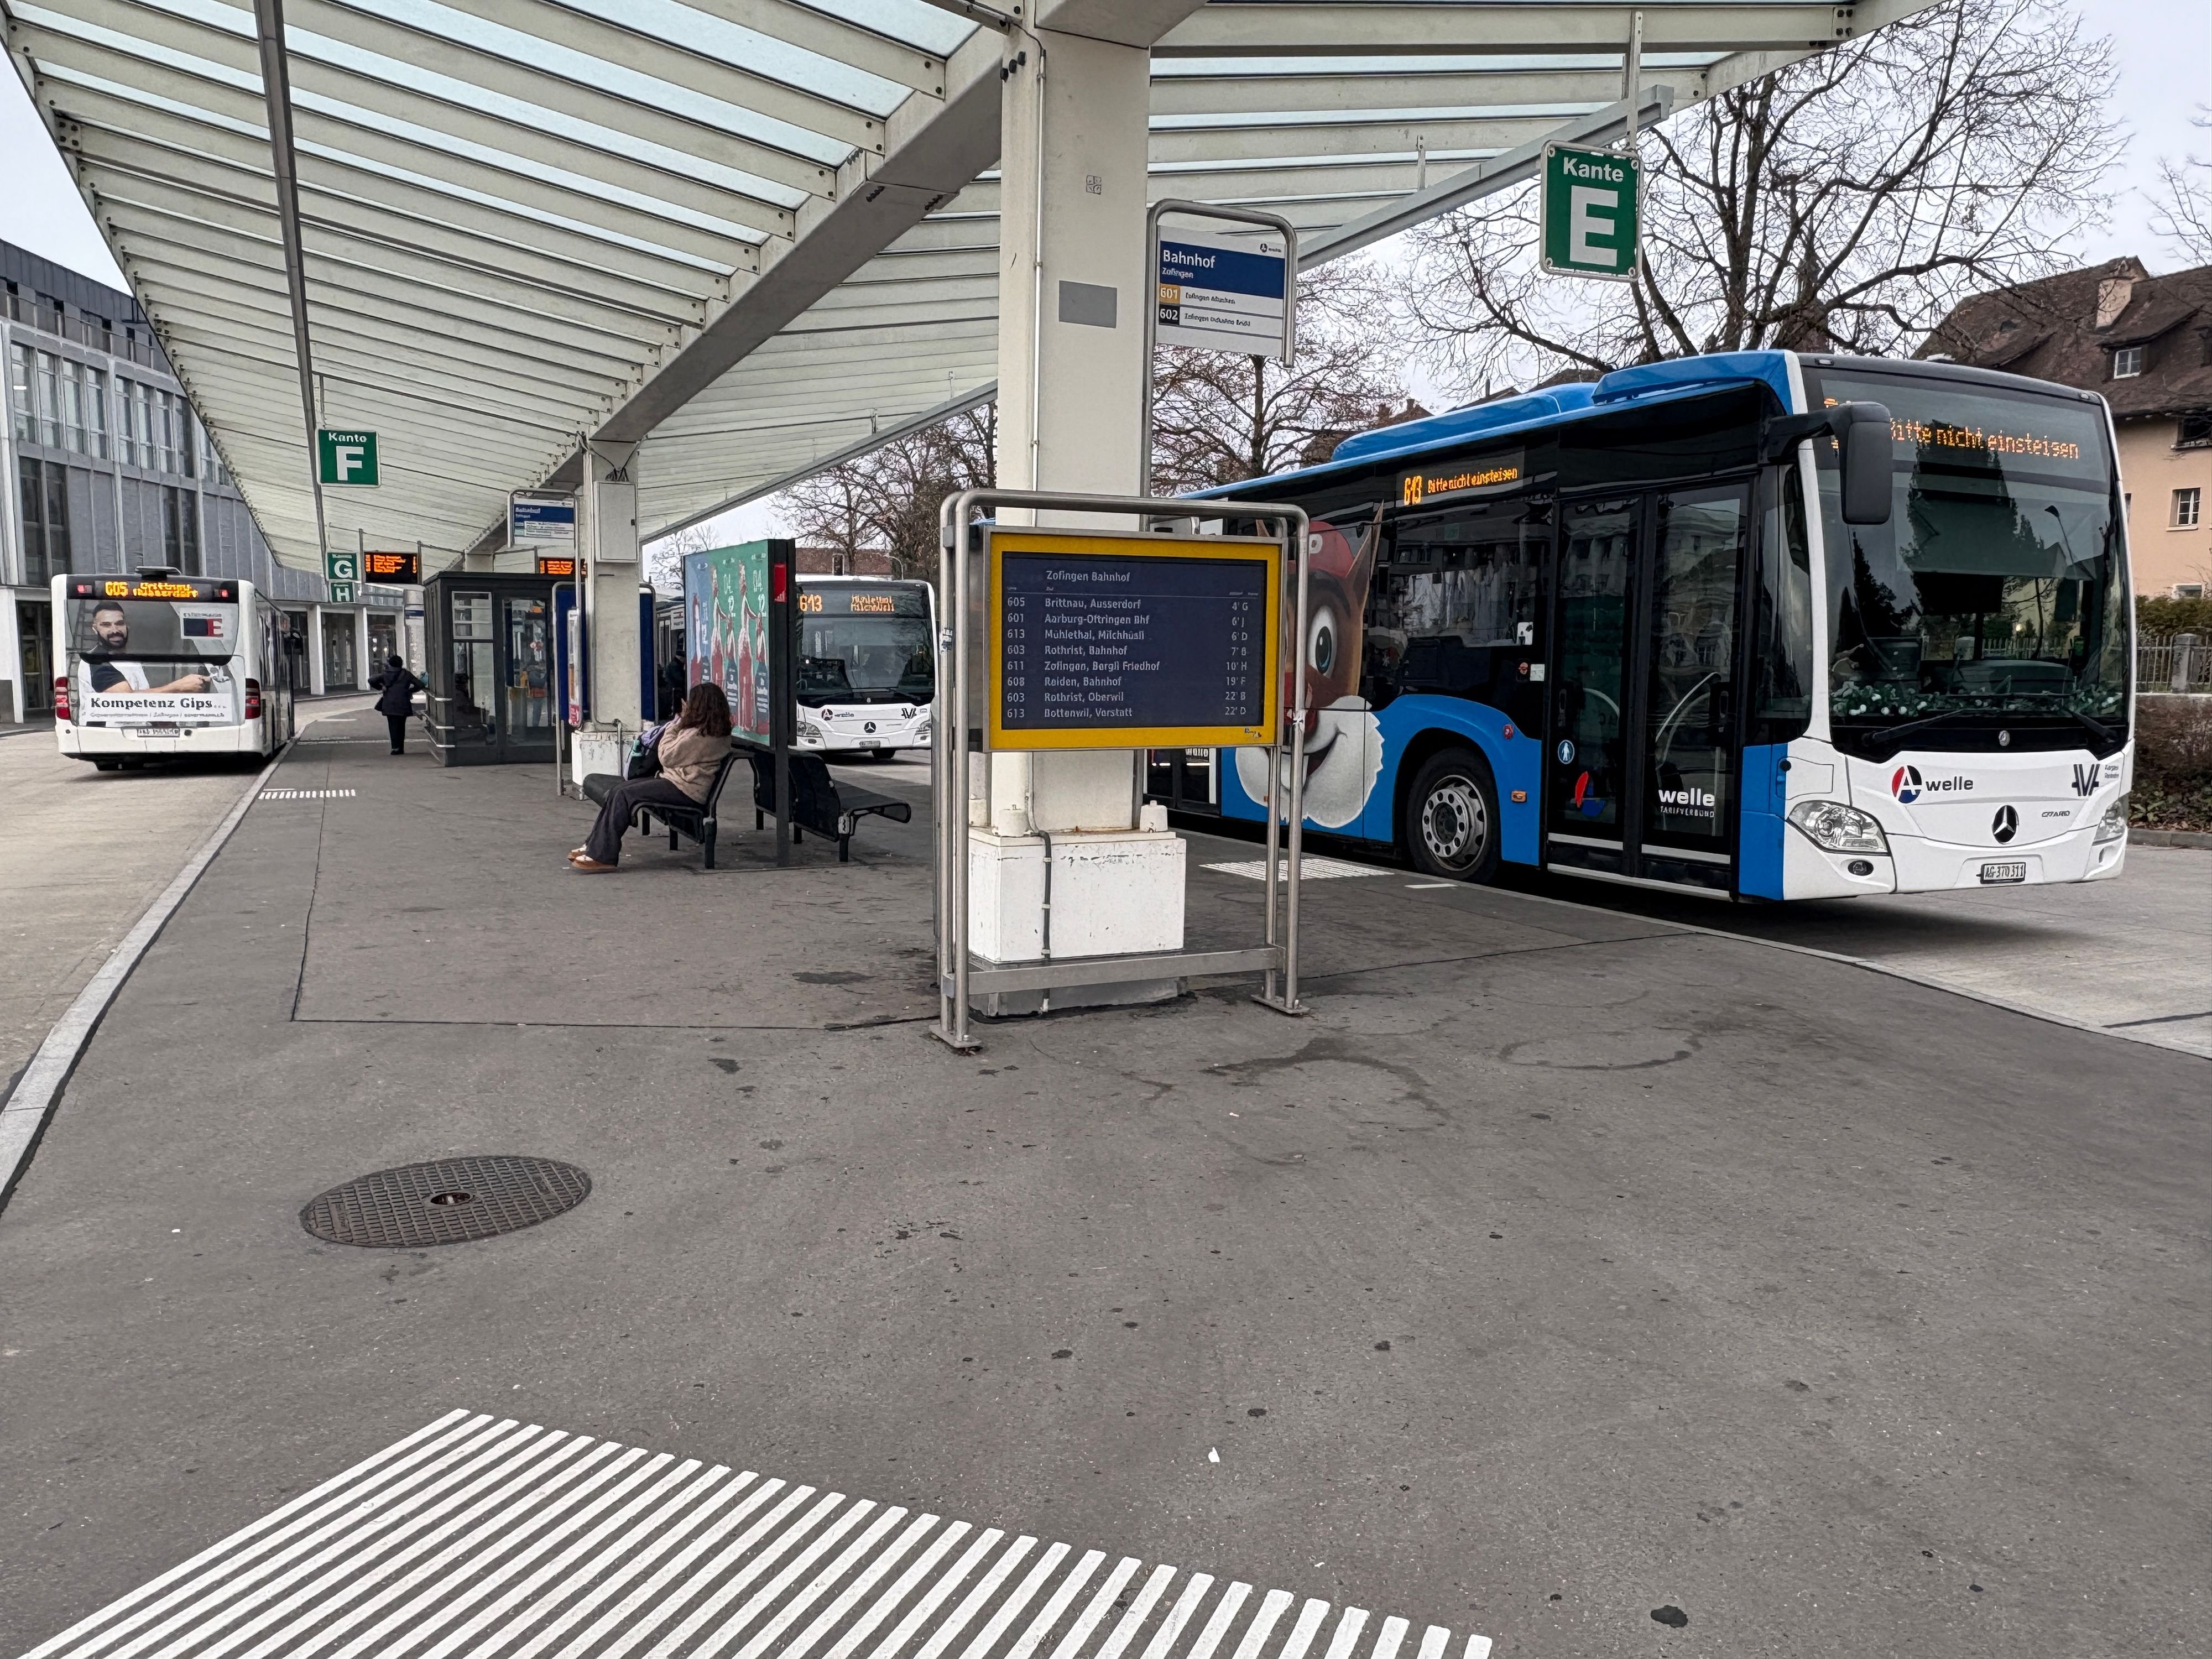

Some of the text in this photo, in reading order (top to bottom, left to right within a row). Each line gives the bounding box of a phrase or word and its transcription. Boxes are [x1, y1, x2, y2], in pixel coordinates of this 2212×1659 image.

[1563, 156, 1624, 182] Kante
[1569, 185, 1619, 267] E
[1163, 249, 1215, 269] Bahnhof
[1160, 288, 1178, 299] 601
[1160, 309, 1178, 320] 602
[1937, 425, 1984, 449] nicht
[336, 446, 364, 481] F
[334, 560, 353, 578] G
[1046, 571, 1130, 582] Zofingen Bahnhof
[336, 587, 350, 602] H
[800, 594, 822, 612] 613
[1008, 597, 1025, 607] 605
[1045, 598, 1087, 609] Brittnau,
[1090, 598, 1141, 609] Ausserdorf
[1242, 602, 1248, 611] G
[1008, 613, 1024, 622] 601
[1045, 614, 1131, 625] Aarburg-Oftringen
[1134, 615, 1150, 624] Bhf
[1008, 629, 1025, 639] 613
[1241, 632, 1248, 640] D
[1008, 645, 1025, 655] 603
[1045, 645, 1086, 656] Rothrist,
[1089, 645, 1128, 655] Bahnhof
[1008, 661, 1024, 670] 611
[1045, 661, 1089, 672] Zofingen,
[1123, 661, 1160, 671] Friedhof
[1241, 661, 1247, 671] H
[1008, 677, 1025, 686] 608
[1045, 677, 1080, 687] Reiden,
[1083, 676, 1122, 686] Bahnhof
[1241, 677, 1246, 686] F
[91, 697, 175, 710] Kompetenz
[1007, 693, 1025, 702] 603
[1045, 693, 1084, 703] Rothrist,
[1088, 692, 1124, 702] Oberwil
[1240, 692, 1246, 701] B
[1007, 709, 1025, 718] 613
[1045, 708, 1092, 718] Bottenwil,
[1240, 707, 1246, 715] D
[1926, 776, 1974, 791] welle
[1659, 787, 1715, 806] welle
[1660, 806, 1715, 818] TARIFVERBUND
